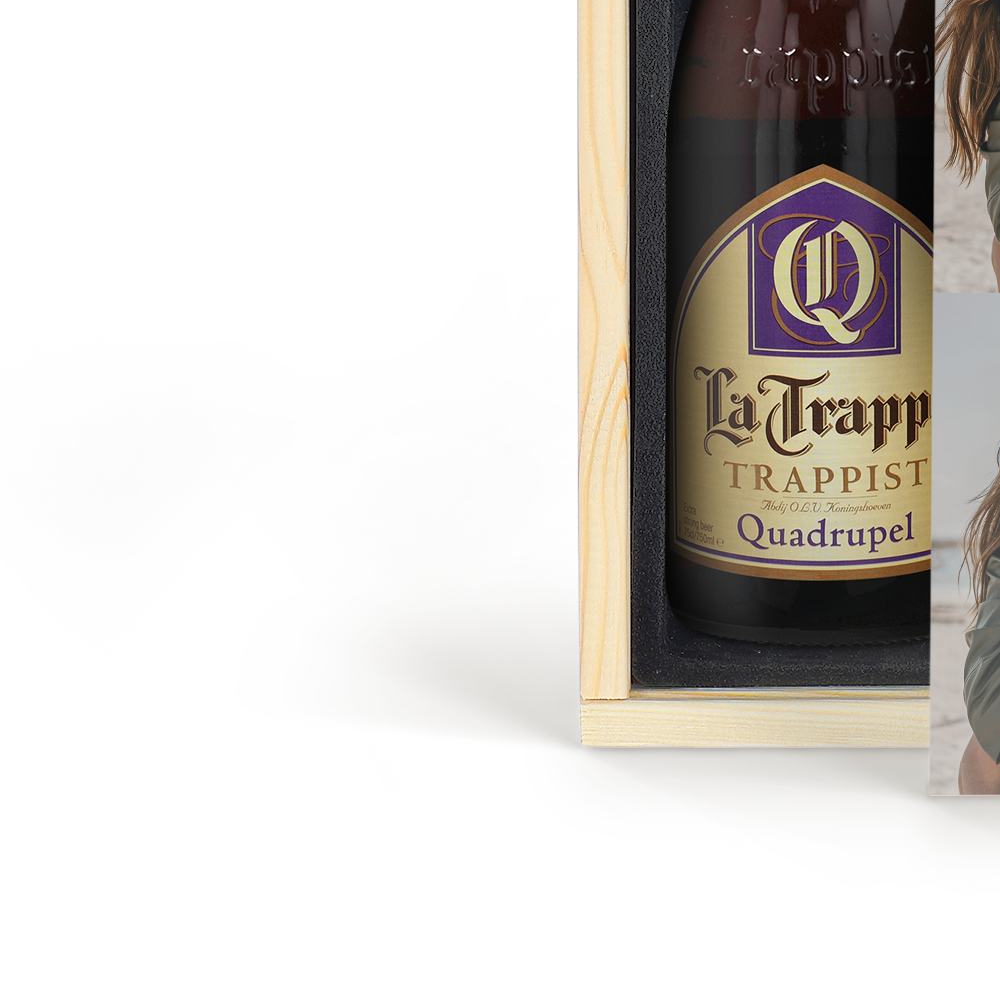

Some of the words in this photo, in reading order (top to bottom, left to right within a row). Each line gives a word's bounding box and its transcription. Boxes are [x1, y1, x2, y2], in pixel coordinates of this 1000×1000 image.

[693, 365, 763, 457] La
[757, 369, 933, 458] Trapp
[723, 458, 928, 494] TRAPPIST
[759, 499, 788, 515] Abdij
[825, 501, 892, 516] Koningshoeven
[700, 521, 714, 533] beer
[737, 513, 915, 553] Quadrupel
